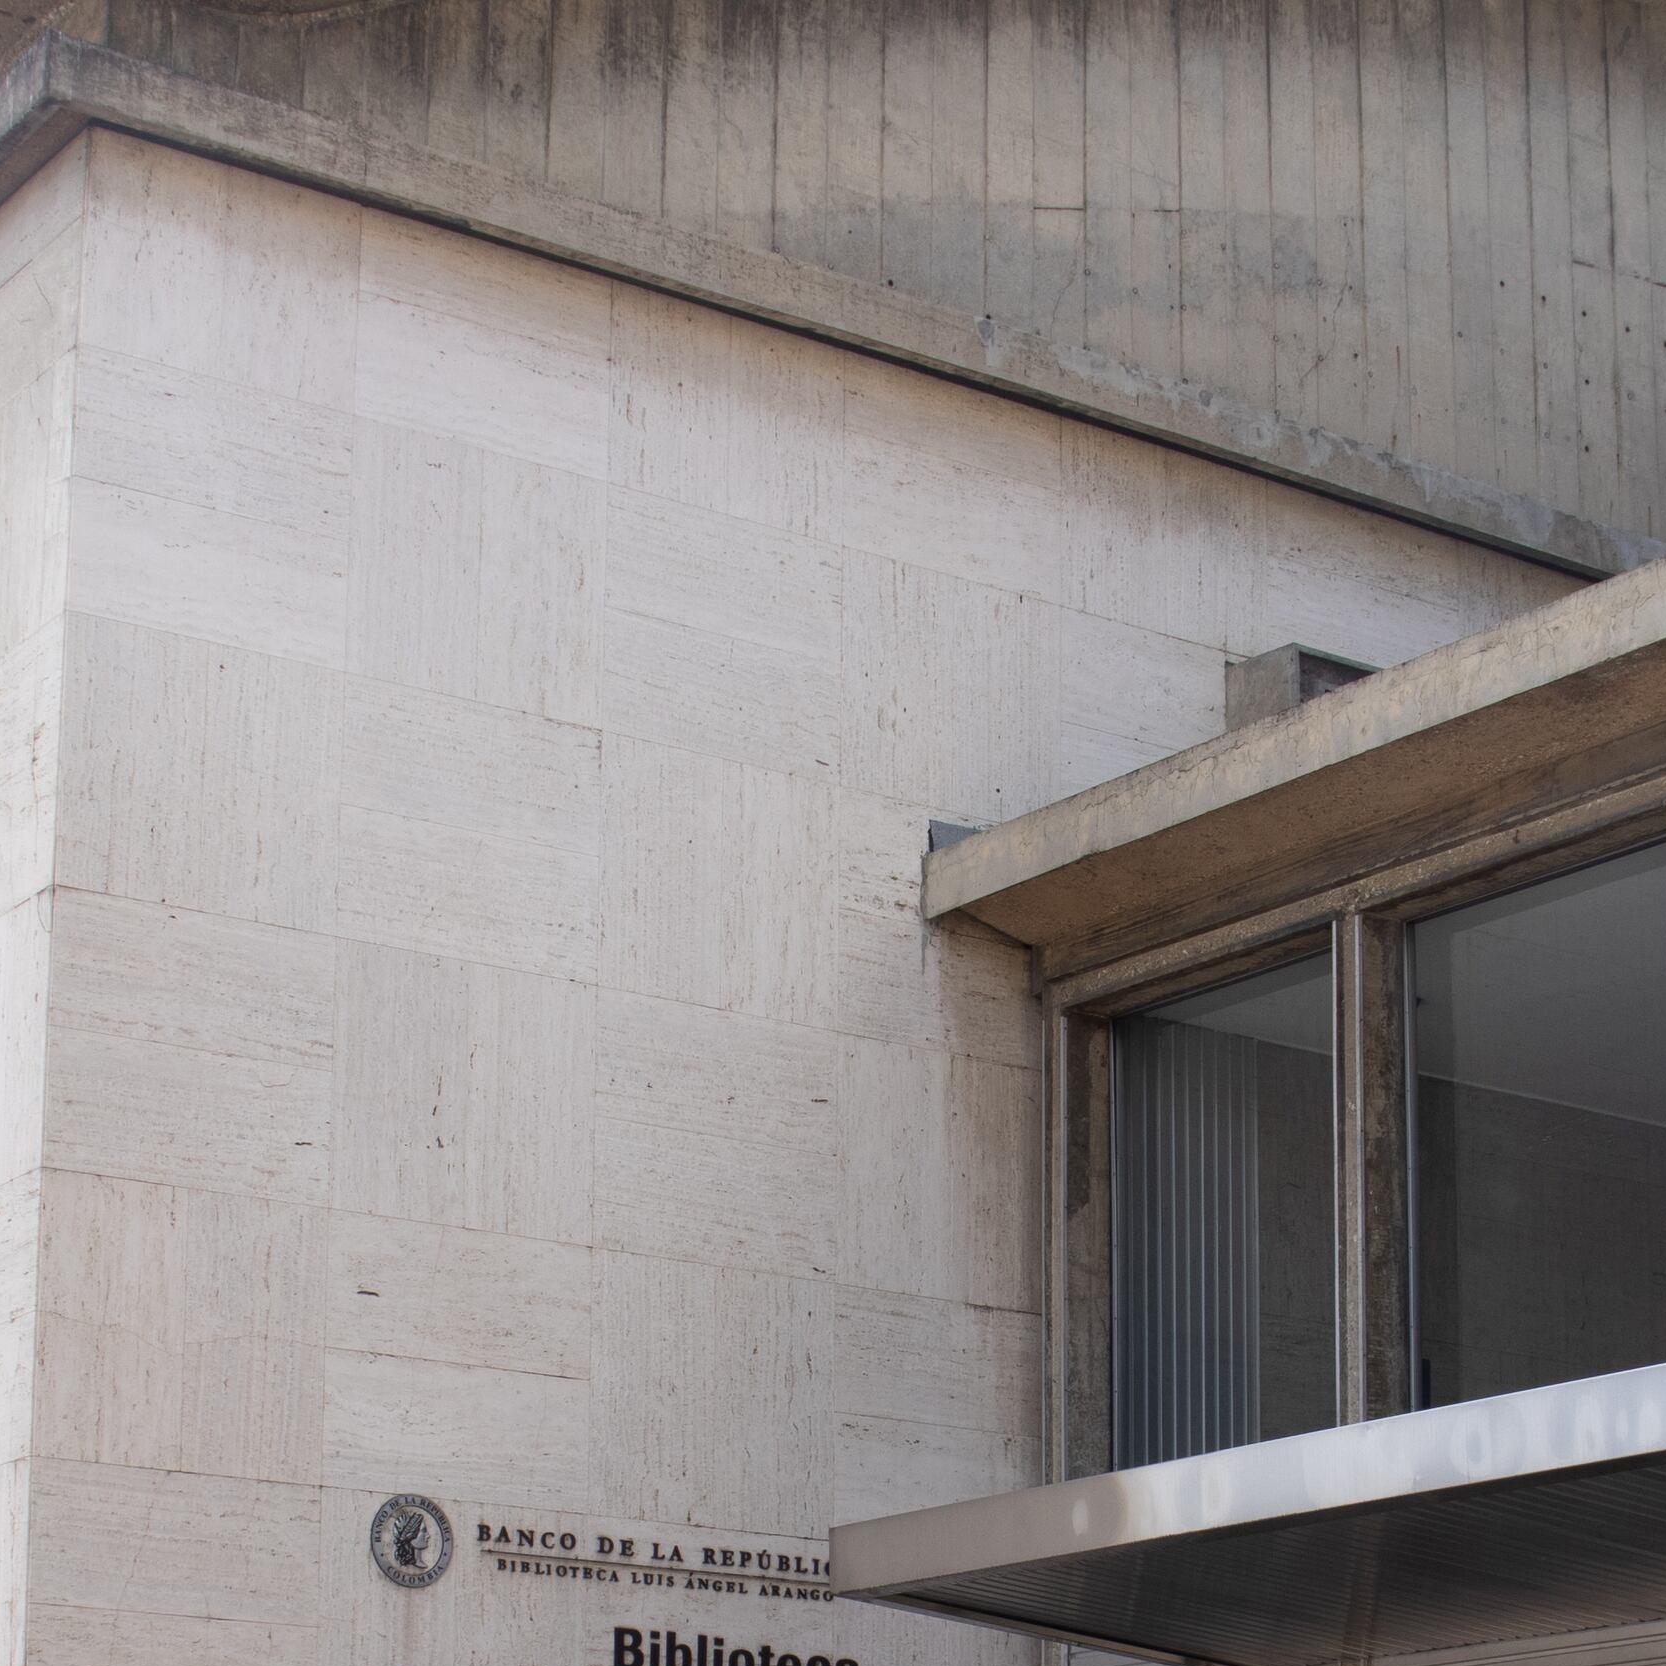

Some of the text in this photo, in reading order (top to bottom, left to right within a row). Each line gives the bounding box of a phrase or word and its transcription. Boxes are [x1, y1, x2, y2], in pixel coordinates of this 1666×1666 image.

[389, 1500, 402, 1511] DE
[477, 1524, 577, 1550] BANCO
[597, 1536, 635, 1557] DE
[651, 1543, 684, 1562] LA
[386, 1565, 444, 1584] COLOMBIA
[497, 1558, 834, 1602] BIBLIOTECA LUIS ÁNGEL ARANGO
